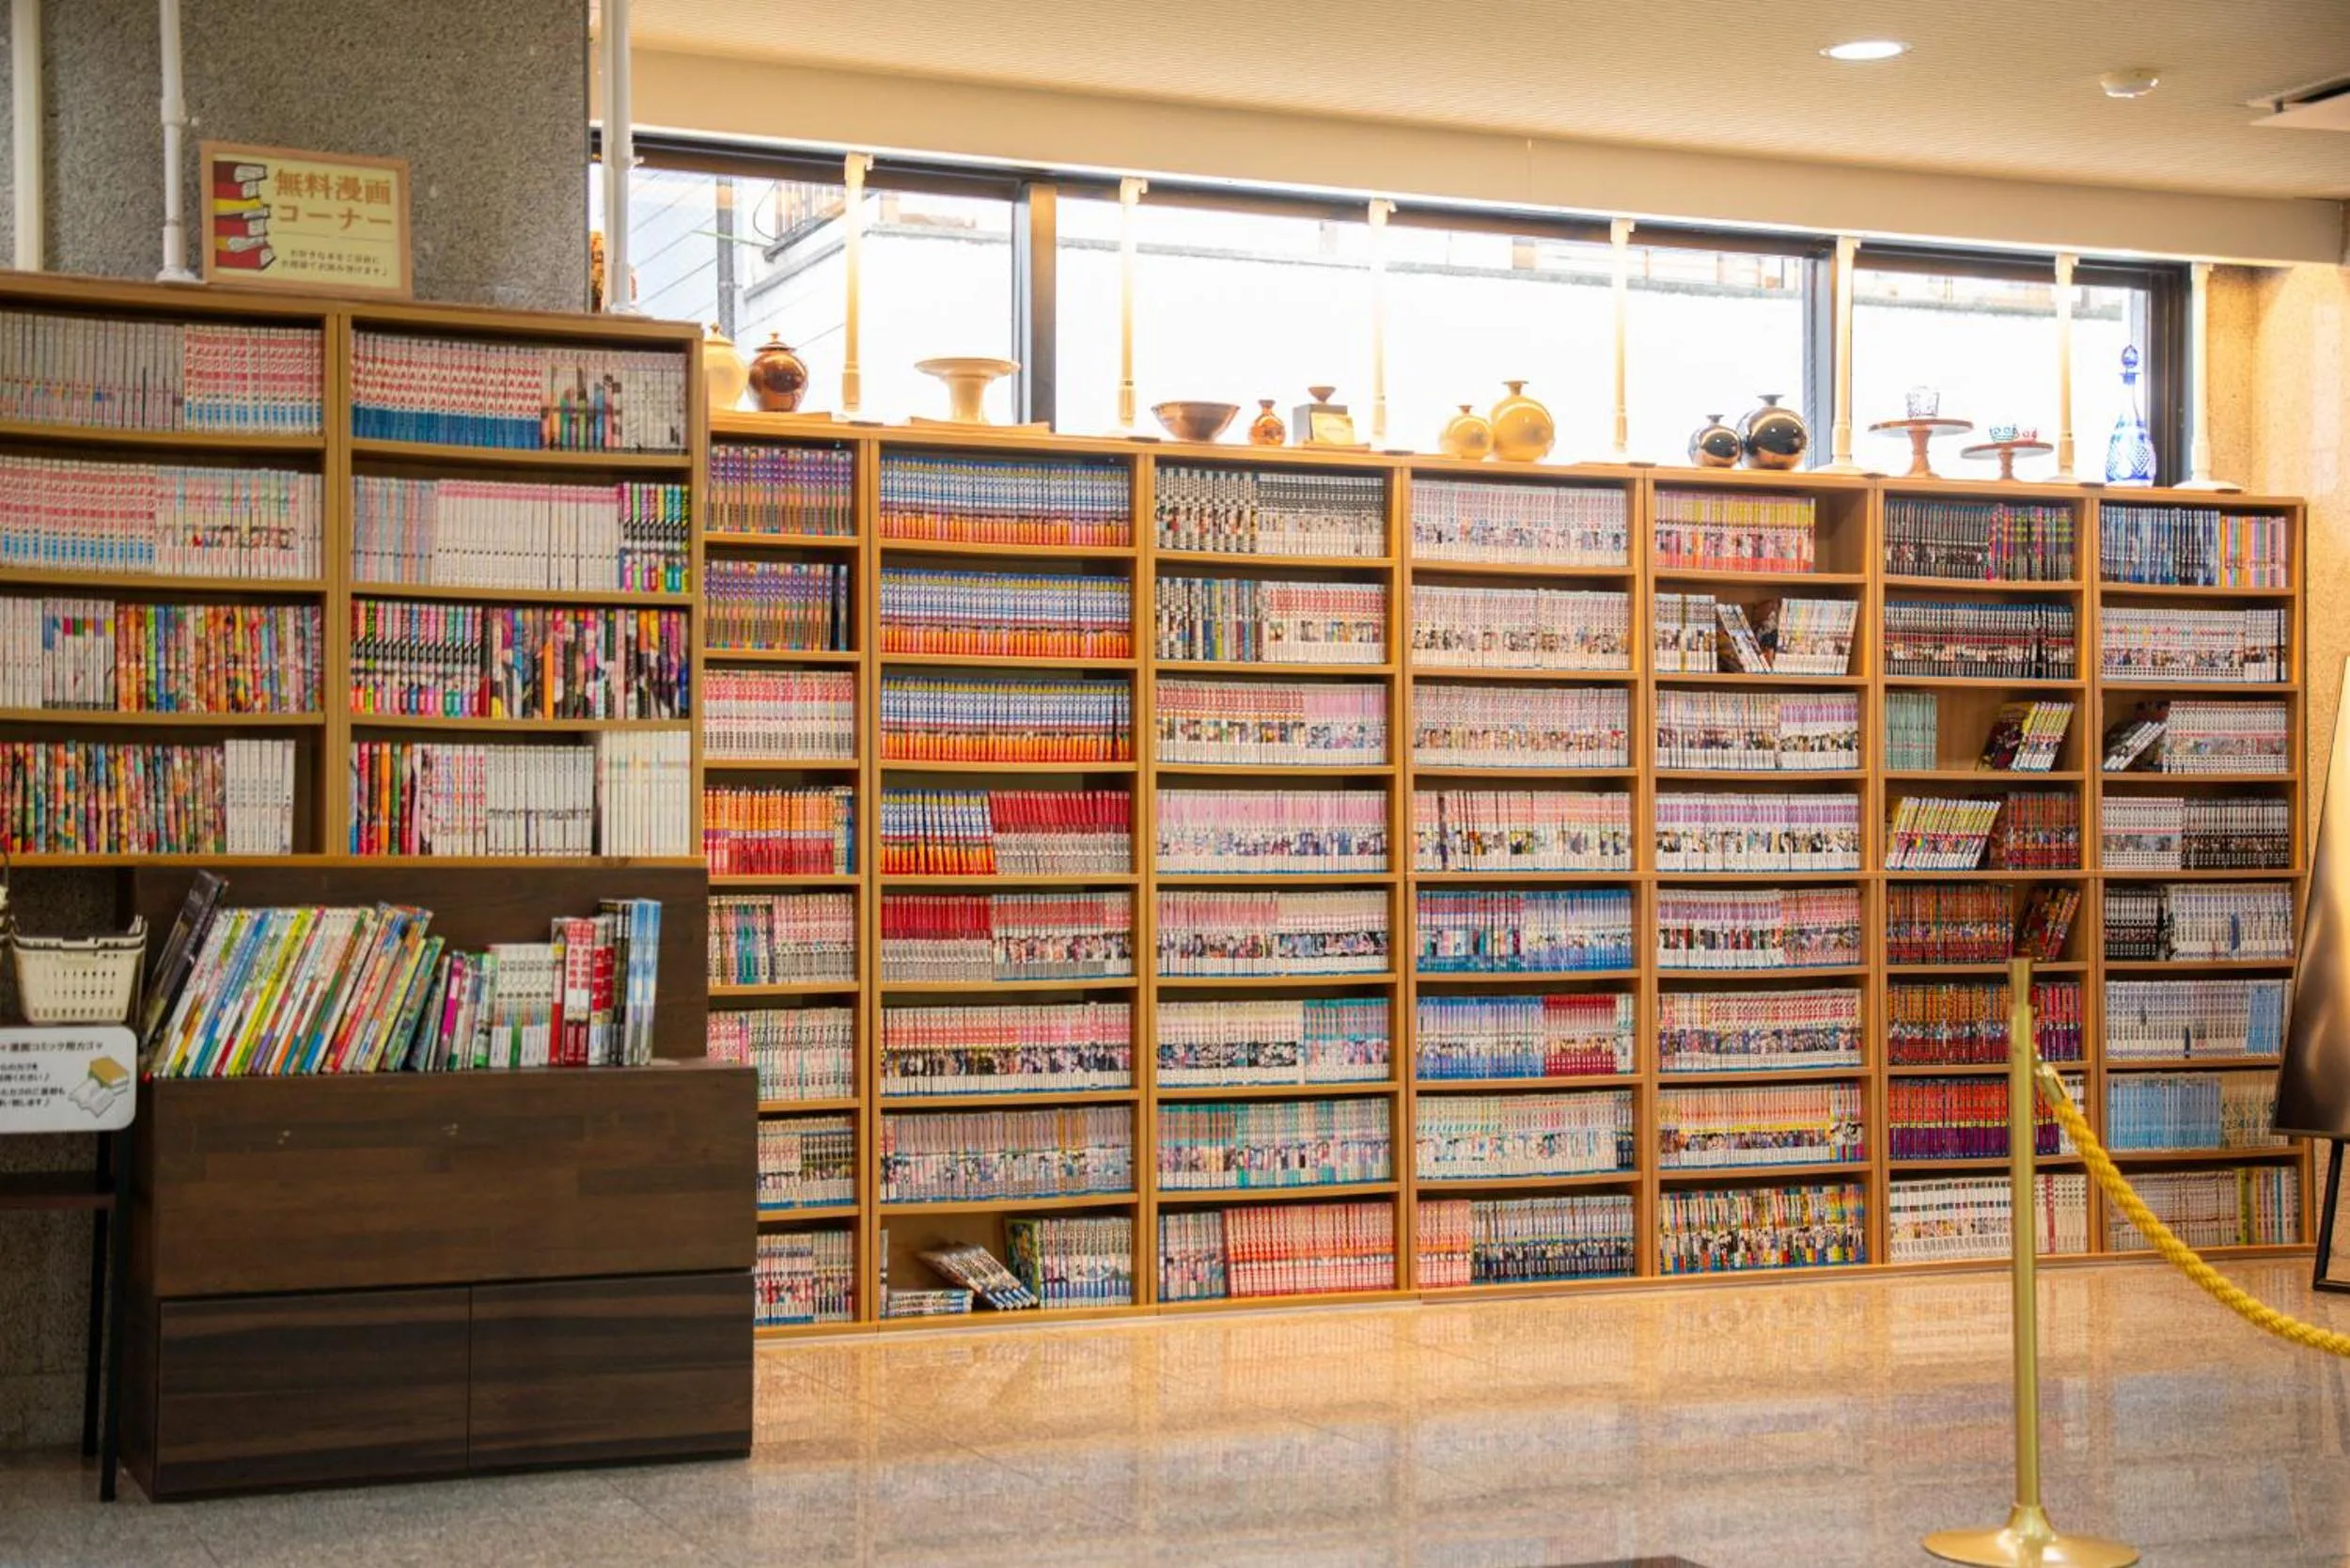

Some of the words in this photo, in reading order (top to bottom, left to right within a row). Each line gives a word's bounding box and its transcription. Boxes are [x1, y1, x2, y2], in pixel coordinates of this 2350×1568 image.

[274, 169, 391, 206] 無料漫画
[278, 204, 392, 230] コーナー
